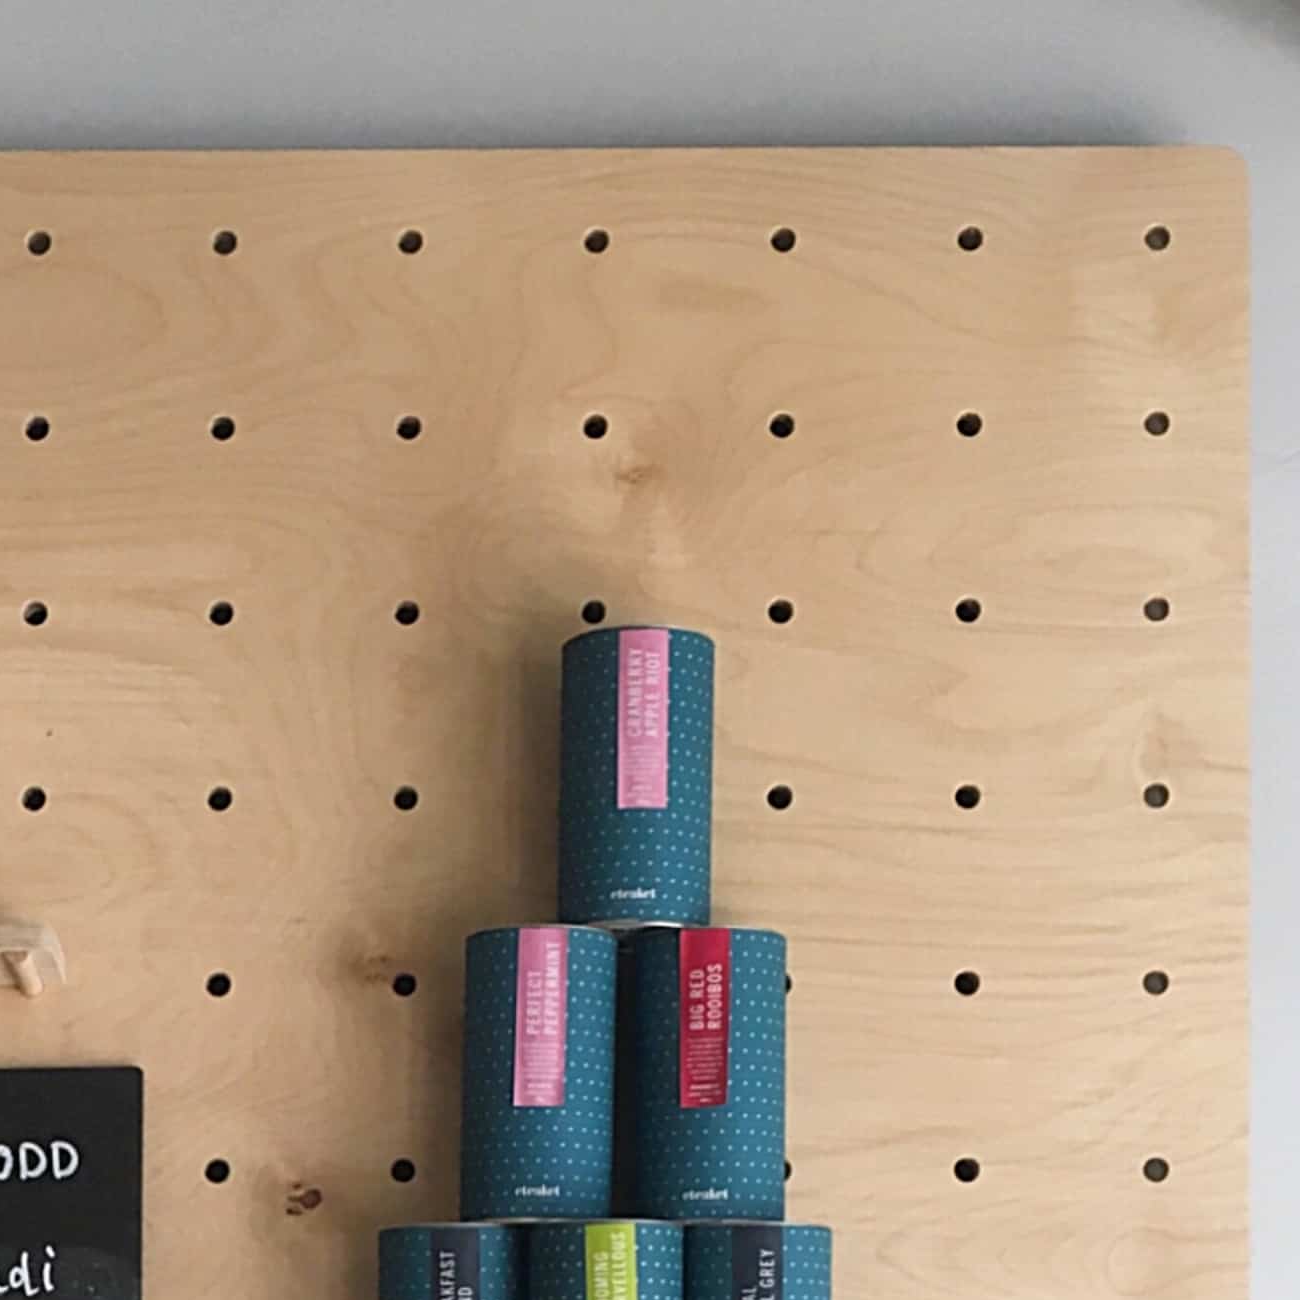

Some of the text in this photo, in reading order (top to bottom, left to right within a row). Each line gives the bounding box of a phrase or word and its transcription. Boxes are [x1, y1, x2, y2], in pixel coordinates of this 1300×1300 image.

[527, 971, 541, 1035] PERFECT
[543, 942, 561, 1035] PEPPERMINT
[690, 969, 705, 1030] BIG RED
[707, 963, 723, 1030] ROOIBOS
[759, 1248, 775, 1287] GREY
